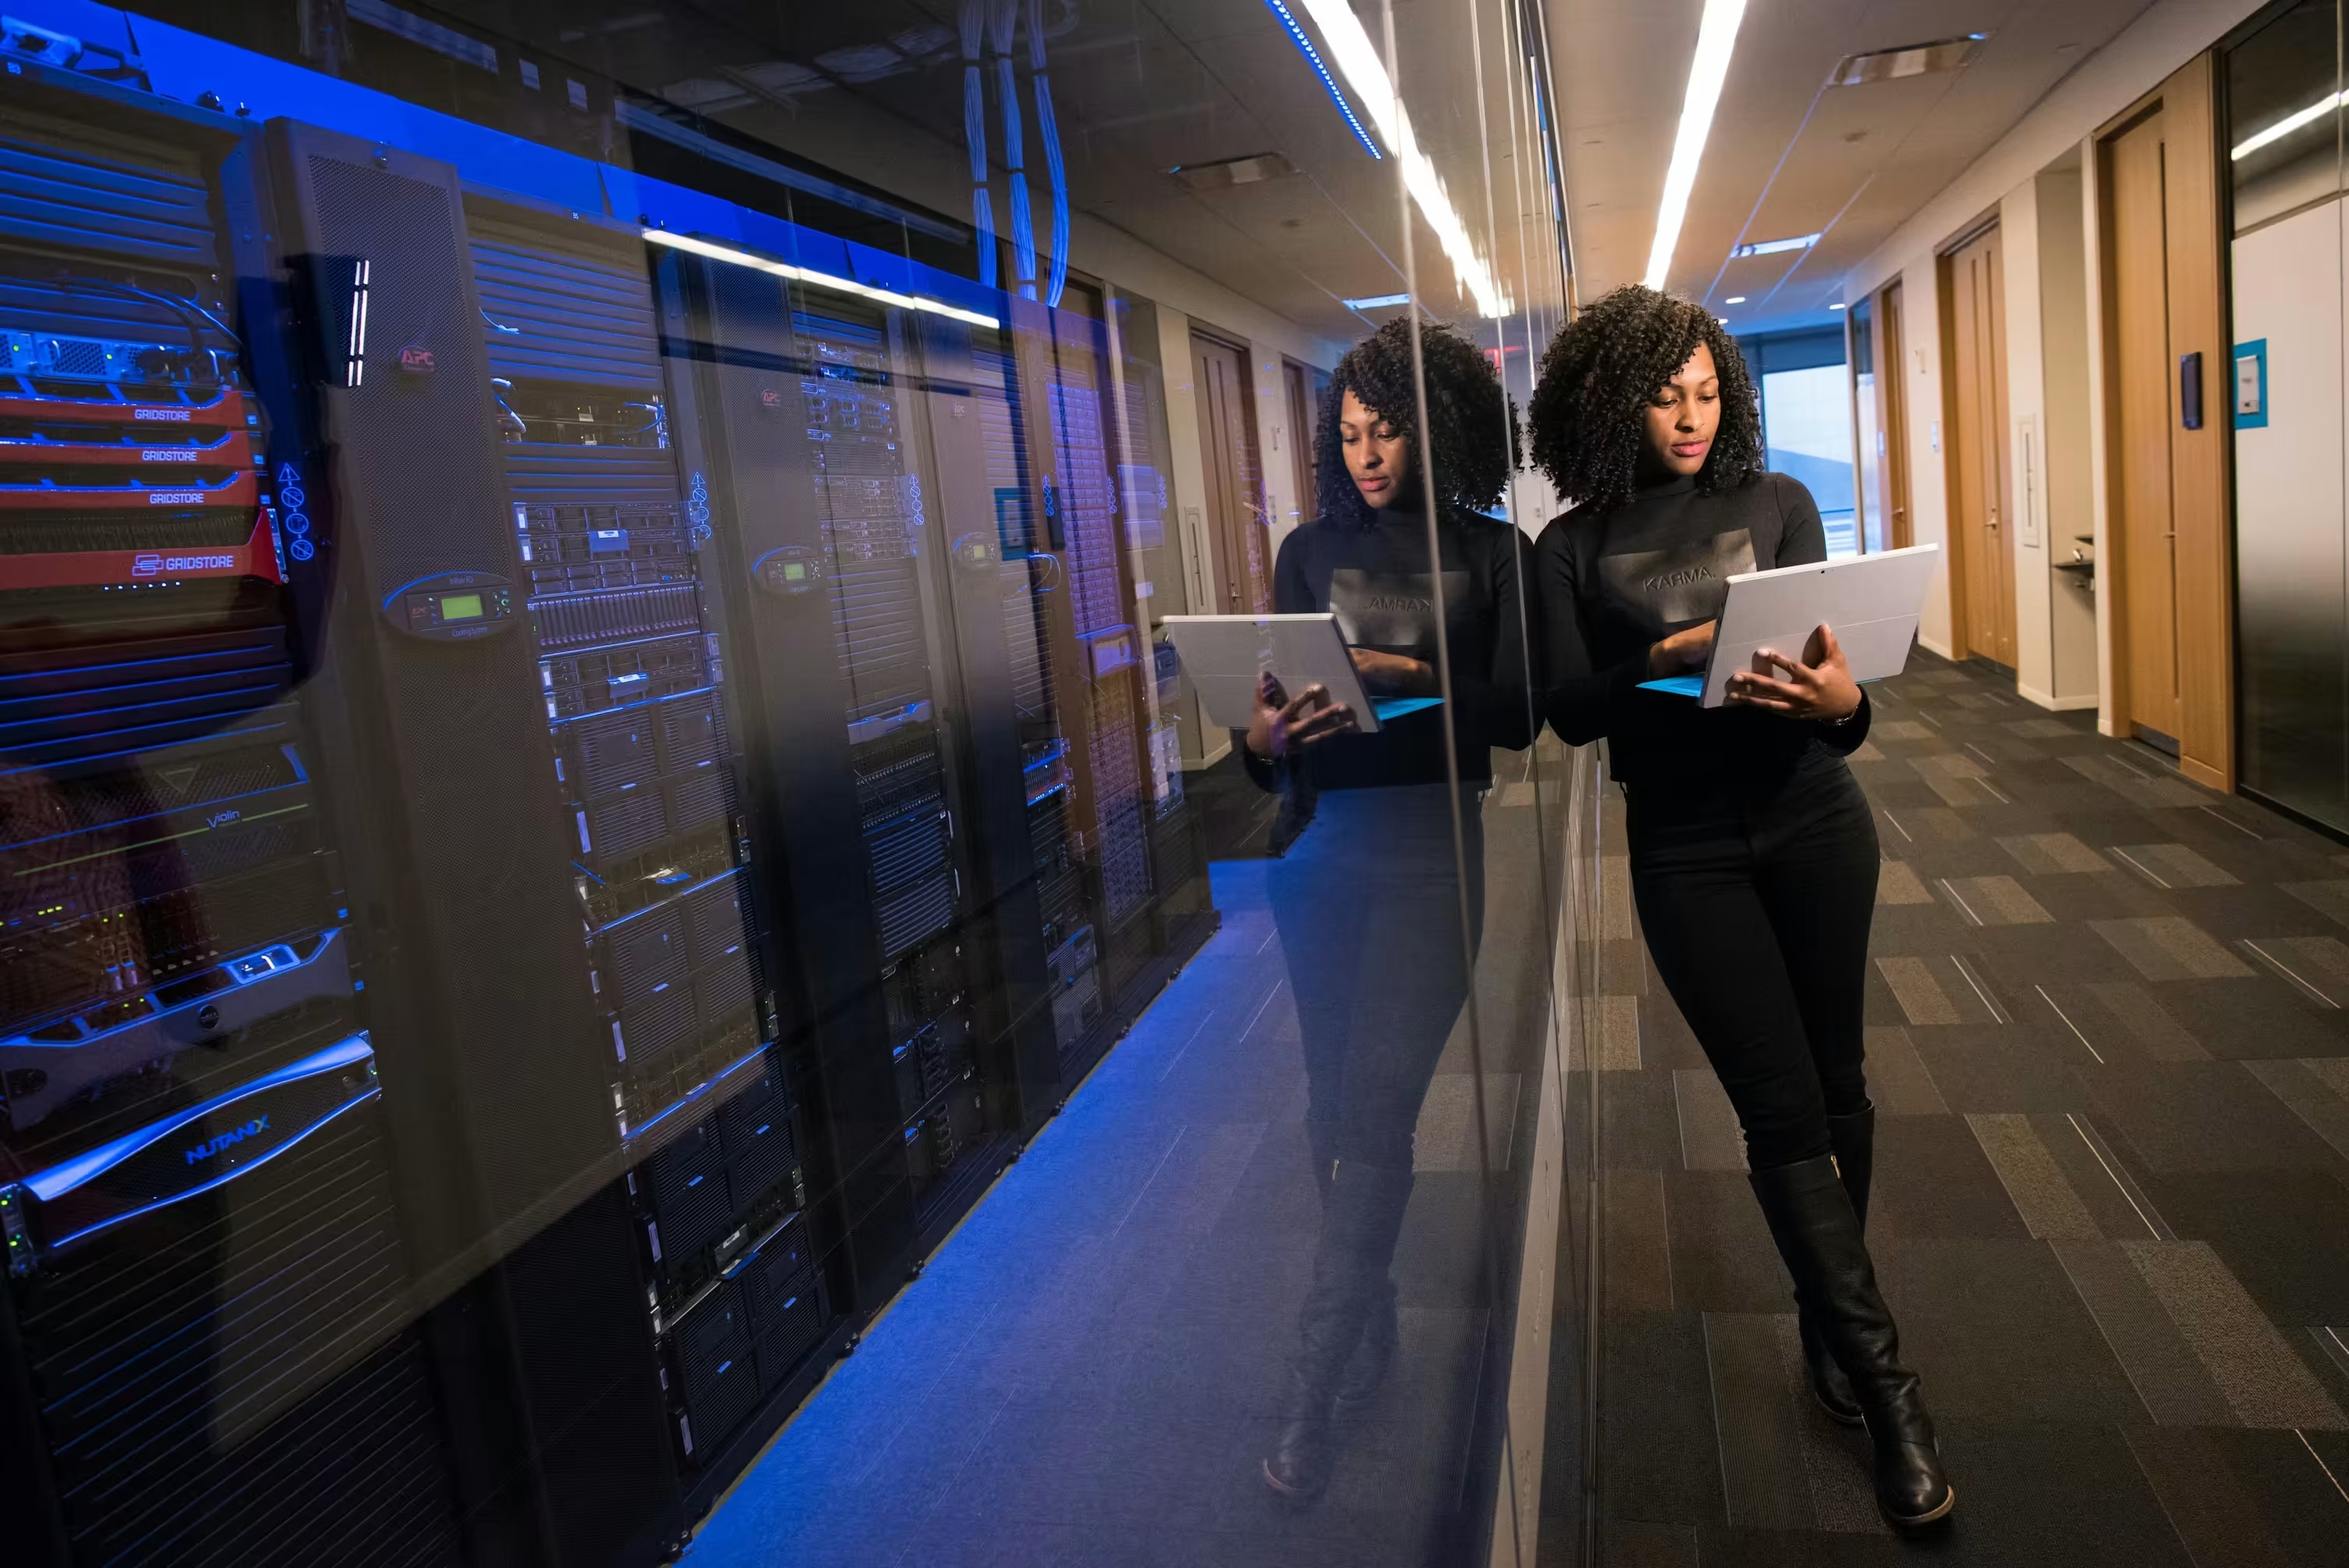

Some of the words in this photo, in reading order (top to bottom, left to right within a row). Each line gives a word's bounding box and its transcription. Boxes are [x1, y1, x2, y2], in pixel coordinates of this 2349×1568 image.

[401, 350, 434, 366] APC
[134, 408, 191, 422] GRIDSTORE
[142, 450, 198, 462] GRIDSTORE
[149, 493, 205, 504] GRIDSTORE
[166, 555, 233, 571] GRIDSTORE
[206, 810, 240, 828] Violin
[185, 1114, 271, 1165] NUTANIX
